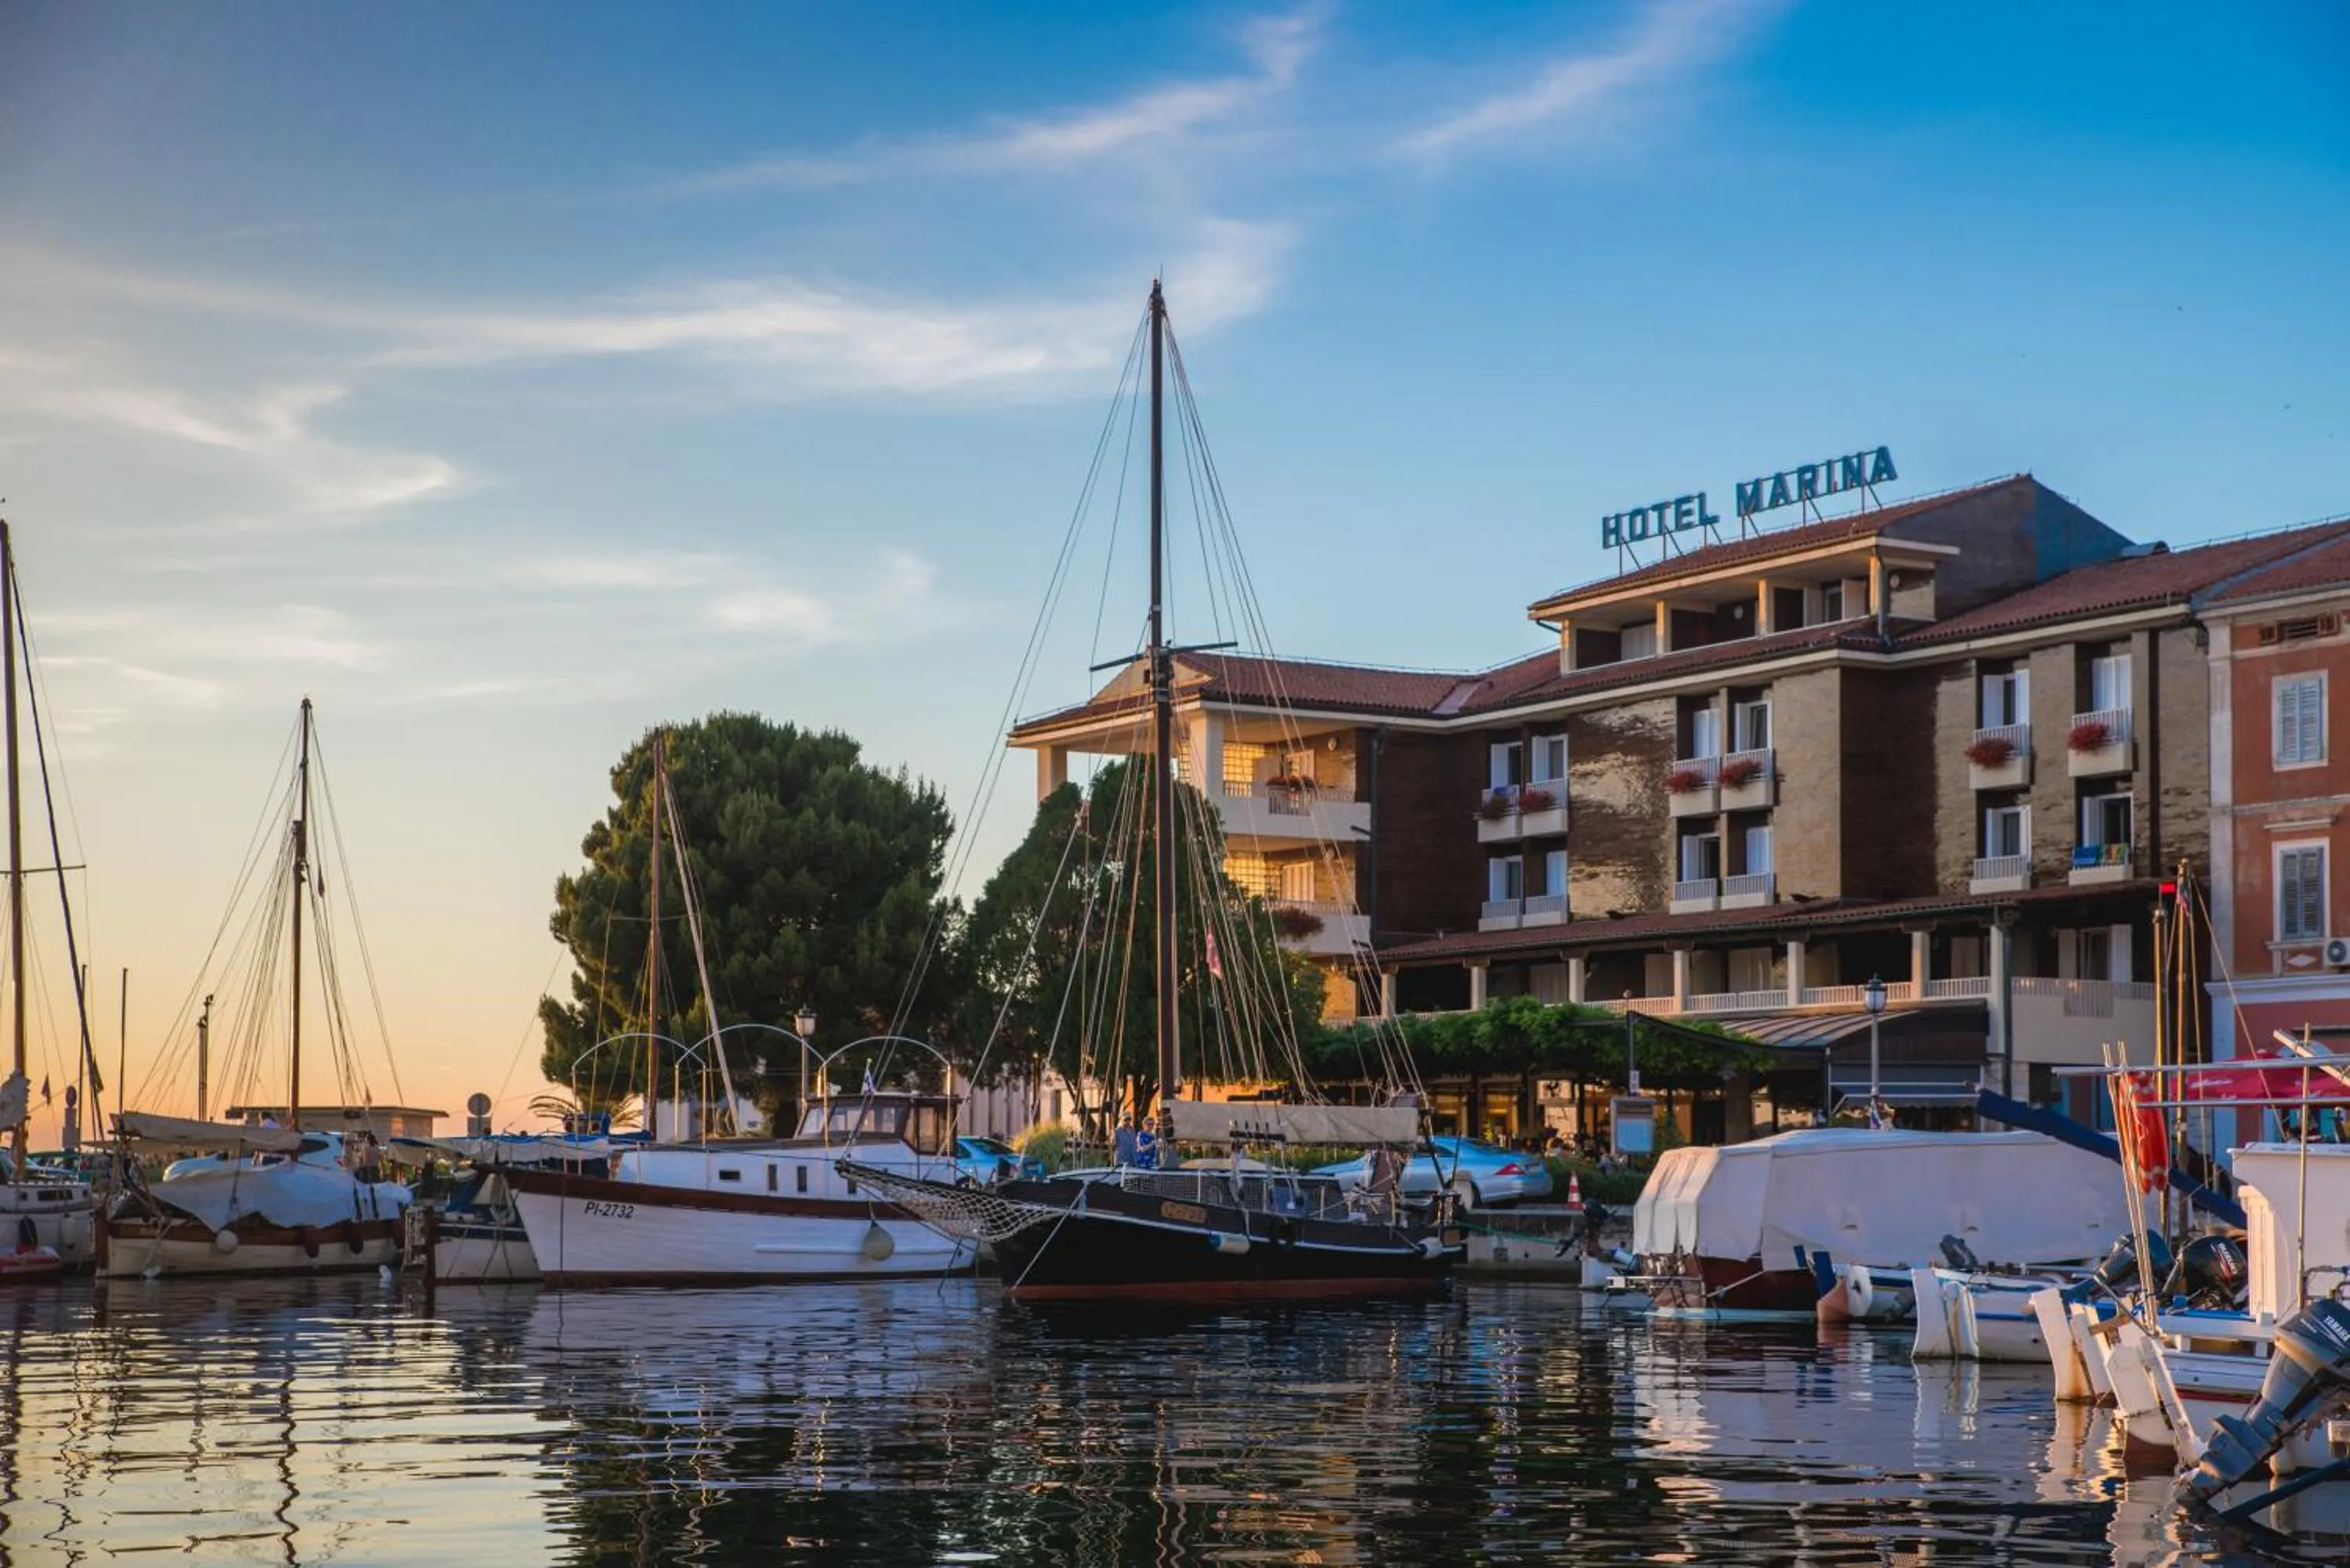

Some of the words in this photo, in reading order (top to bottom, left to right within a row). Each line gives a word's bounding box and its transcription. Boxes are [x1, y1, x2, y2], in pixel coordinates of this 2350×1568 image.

[1602, 492, 1720, 549] HOTEL
[1736, 445, 1899, 517] MARINA
[584, 1201, 634, 1219] PI-2732
